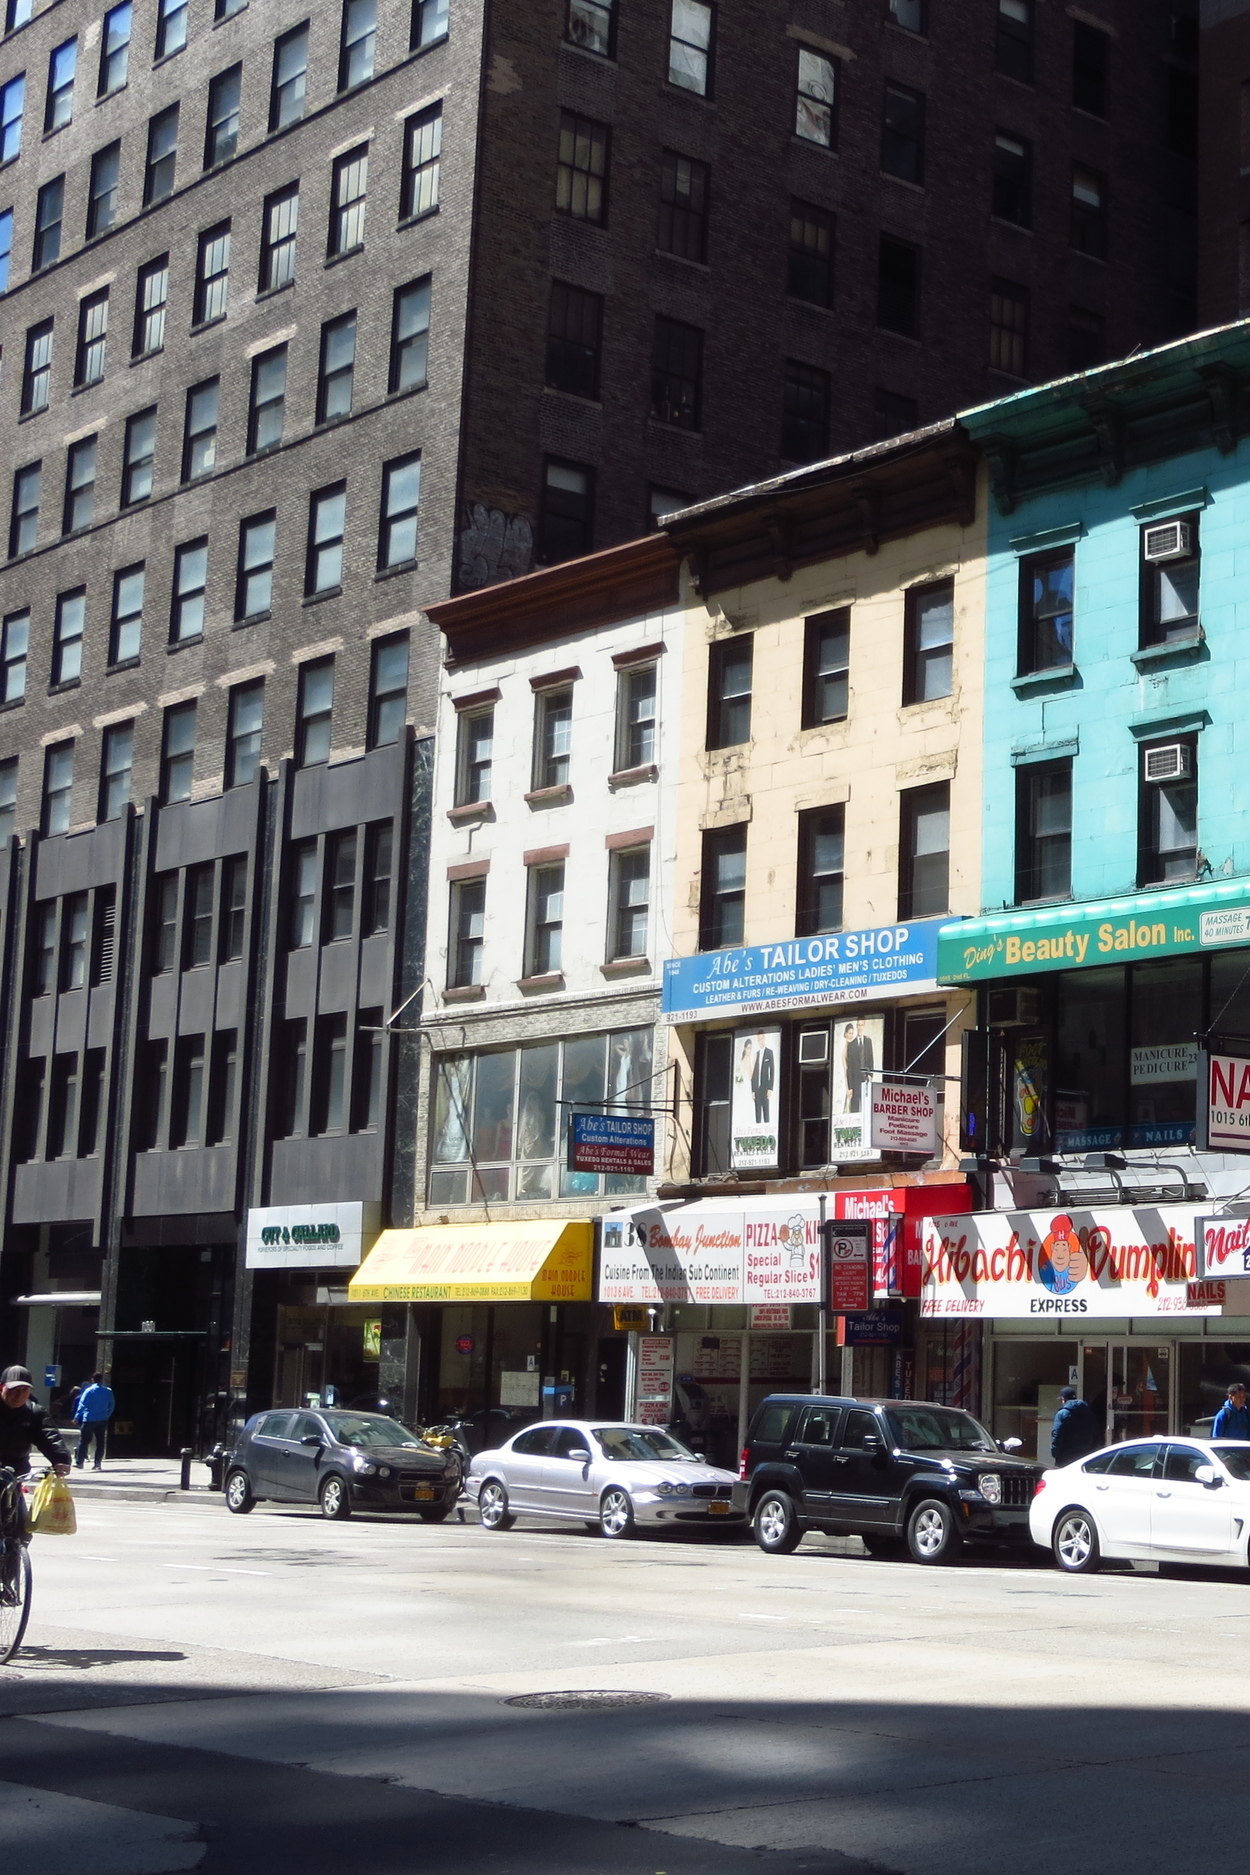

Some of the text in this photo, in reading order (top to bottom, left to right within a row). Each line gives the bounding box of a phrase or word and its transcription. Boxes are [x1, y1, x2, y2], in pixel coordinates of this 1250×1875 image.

[1204, 912, 1243, 926] MASSAGE
[1214, 924, 1244, 937] MINUTES
[963, 919, 1196, 969] Ding's Beauty Salon Inc.
[706, 928, 910, 979] Abe's TAILOR SHOP
[692, 952, 924, 995] CUSTOM ALTERATIONS LADIES' MEN'S CLOTHING
[705, 969, 908, 1005] LEATHER & FURS RE-WEAVING DRY-CLEANING TUXEDOS
[740, 988, 868, 1013] WWW.ABESFORMALWEAR.COM
[666, 1010, 698, 1022] 921-1193
[1133, 1046, 1188, 1063] MANICURE
[1133, 1059, 1188, 1075] PEDICURE
[881, 1087, 930, 1106] Michael's
[873, 1103, 934, 1119] BARBER SHOP
[1210, 1109, 1236, 1125] 1015
[576, 1116, 653, 1136] Abe's TAILOR SHOP
[887, 1115, 920, 1124] Manicure
[888, 1121, 919, 1130] Pedicure
[581, 1133, 647, 1146] Custom Alterations
[879, 1127, 928, 1138] Foot Massage
[1067, 1129, 1183, 1148] MASSAGE NAILS
[733, 1135, 777, 1152] TUXEDO
[578, 1145, 651, 1159] Abe's Formal Wear
[576, 1155, 600, 1163] TUXEDO
[600, 1157, 627, 1165] RENTALS
[845, 1194, 895, 1219] Michael's
[624, 1221, 742, 1256] 38 Bombay Junction
[746, 1222, 778, 1248] PIZZA
[1058, 1230, 1065, 1240] H
[327, 1243, 344, 1251] COFFEE
[408, 1242, 453, 1275] MAIN
[447, 1240, 509, 1274] NOODLE
[498, 1239, 552, 1273] HOUSE
[747, 1253, 781, 1268] Special
[923, 1225, 1197, 1300] Hibachi Dumplin
[542, 1269, 586, 1283] MAIN NOODLE
[604, 1263, 740, 1281] Cuisine From The Indian Sub Continent
[747, 1268, 808, 1287] Regular Slice
[383, 1285, 452, 1299] CHINESE RESTAURANT
[551, 1284, 575, 1297] HOUSE
[696, 1286, 711, 1299] FREE
[711, 1286, 739, 1300] DELIVERY
[763, 1287, 816, 1299] TEL:212-840-3767
[1187, 1281, 1226, 1300] NAILS
[921, 1299, 986, 1313] FREE DELIVERY
[1029, 1298, 1088, 1314] EXPRESS
[620, 1309, 643, 1323] ATM
[848, 1320, 901, 1333] Tailor Shop
[528, 1355, 534, 1367] A
[1070, 1368, 1079, 1380] A
[558, 1394, 567, 1406] P
